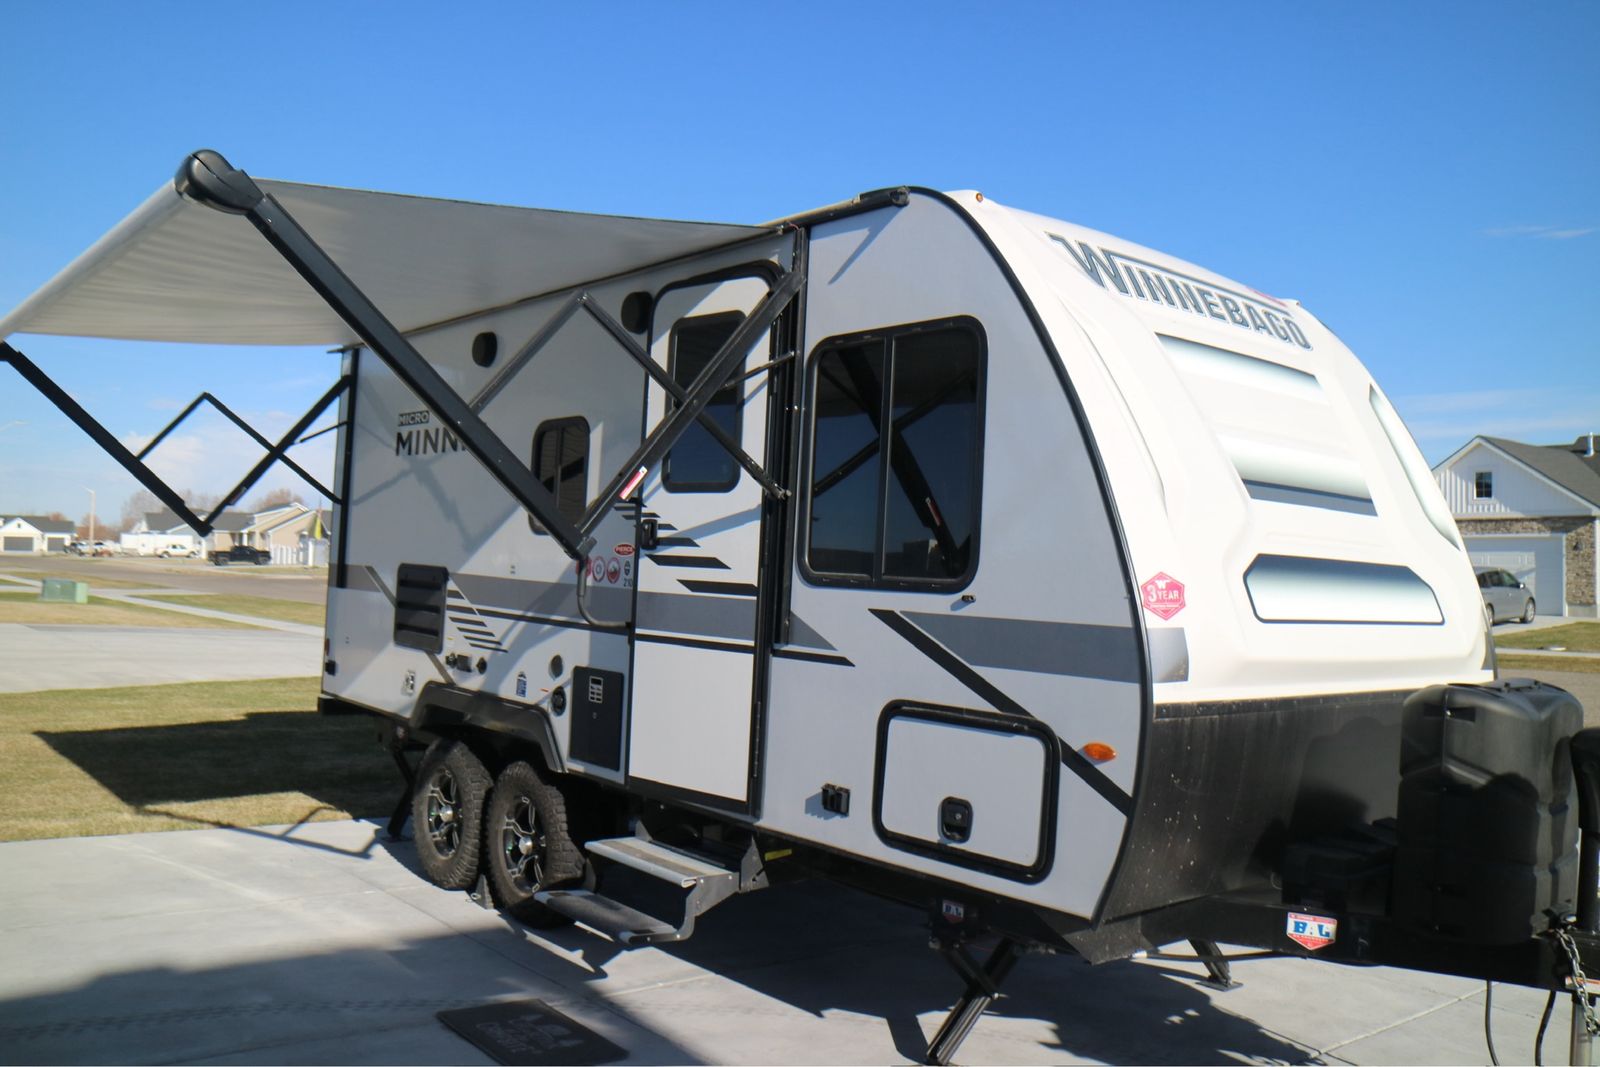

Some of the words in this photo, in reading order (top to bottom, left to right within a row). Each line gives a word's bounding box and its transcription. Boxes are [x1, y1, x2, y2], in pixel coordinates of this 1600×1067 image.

[1044, 231, 1313, 350] WINNEBAGO
[399, 411, 430, 425] MICRO
[1146, 584, 1157, 602] 3
[1157, 590, 1179, 600] YEAR
